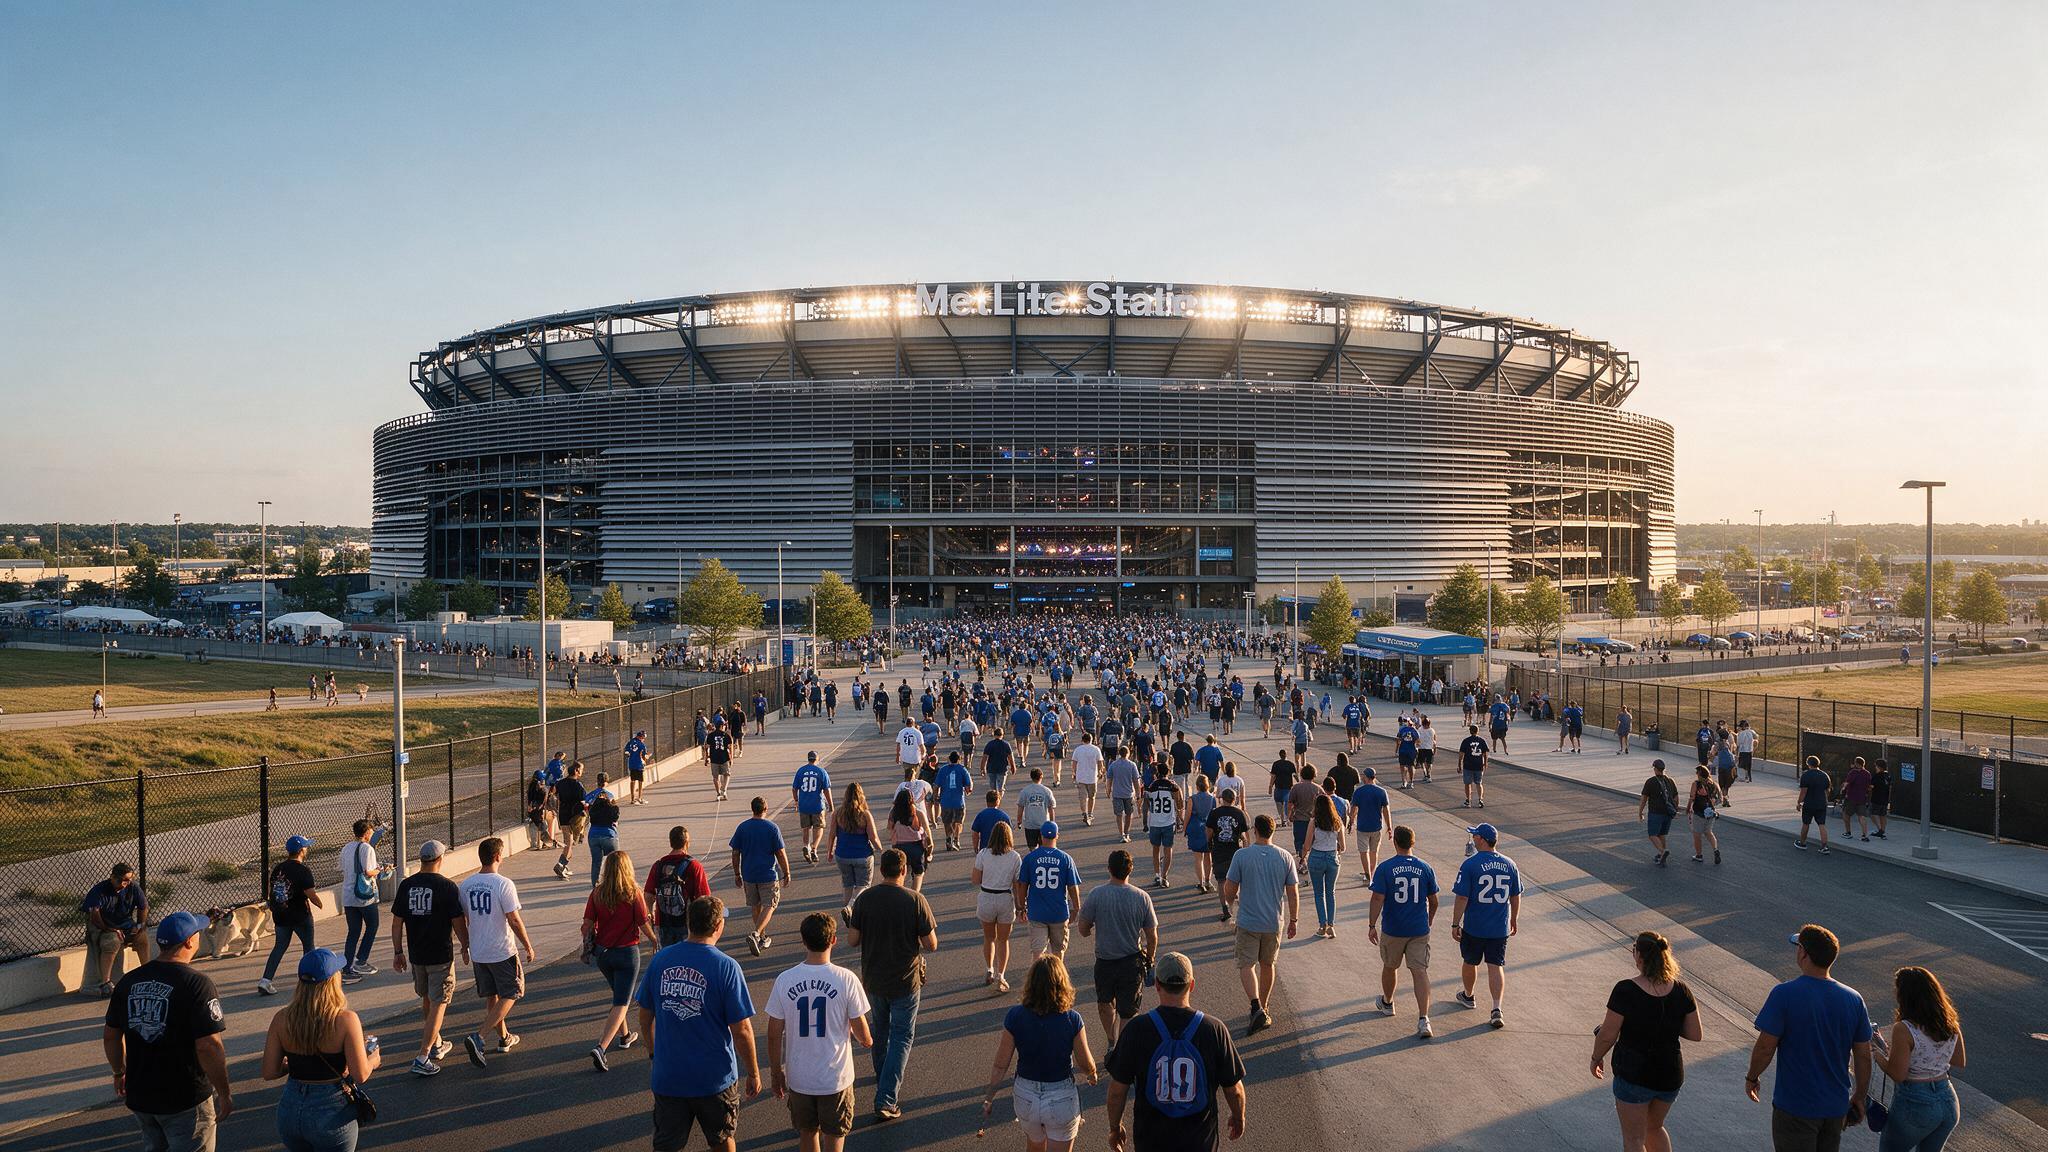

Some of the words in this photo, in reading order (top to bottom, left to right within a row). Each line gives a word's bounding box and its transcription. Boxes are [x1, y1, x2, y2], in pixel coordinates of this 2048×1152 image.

[1394, 877, 1420, 904] 31
[1478, 874, 1511, 904] 25
[796, 996, 827, 1038] 11
